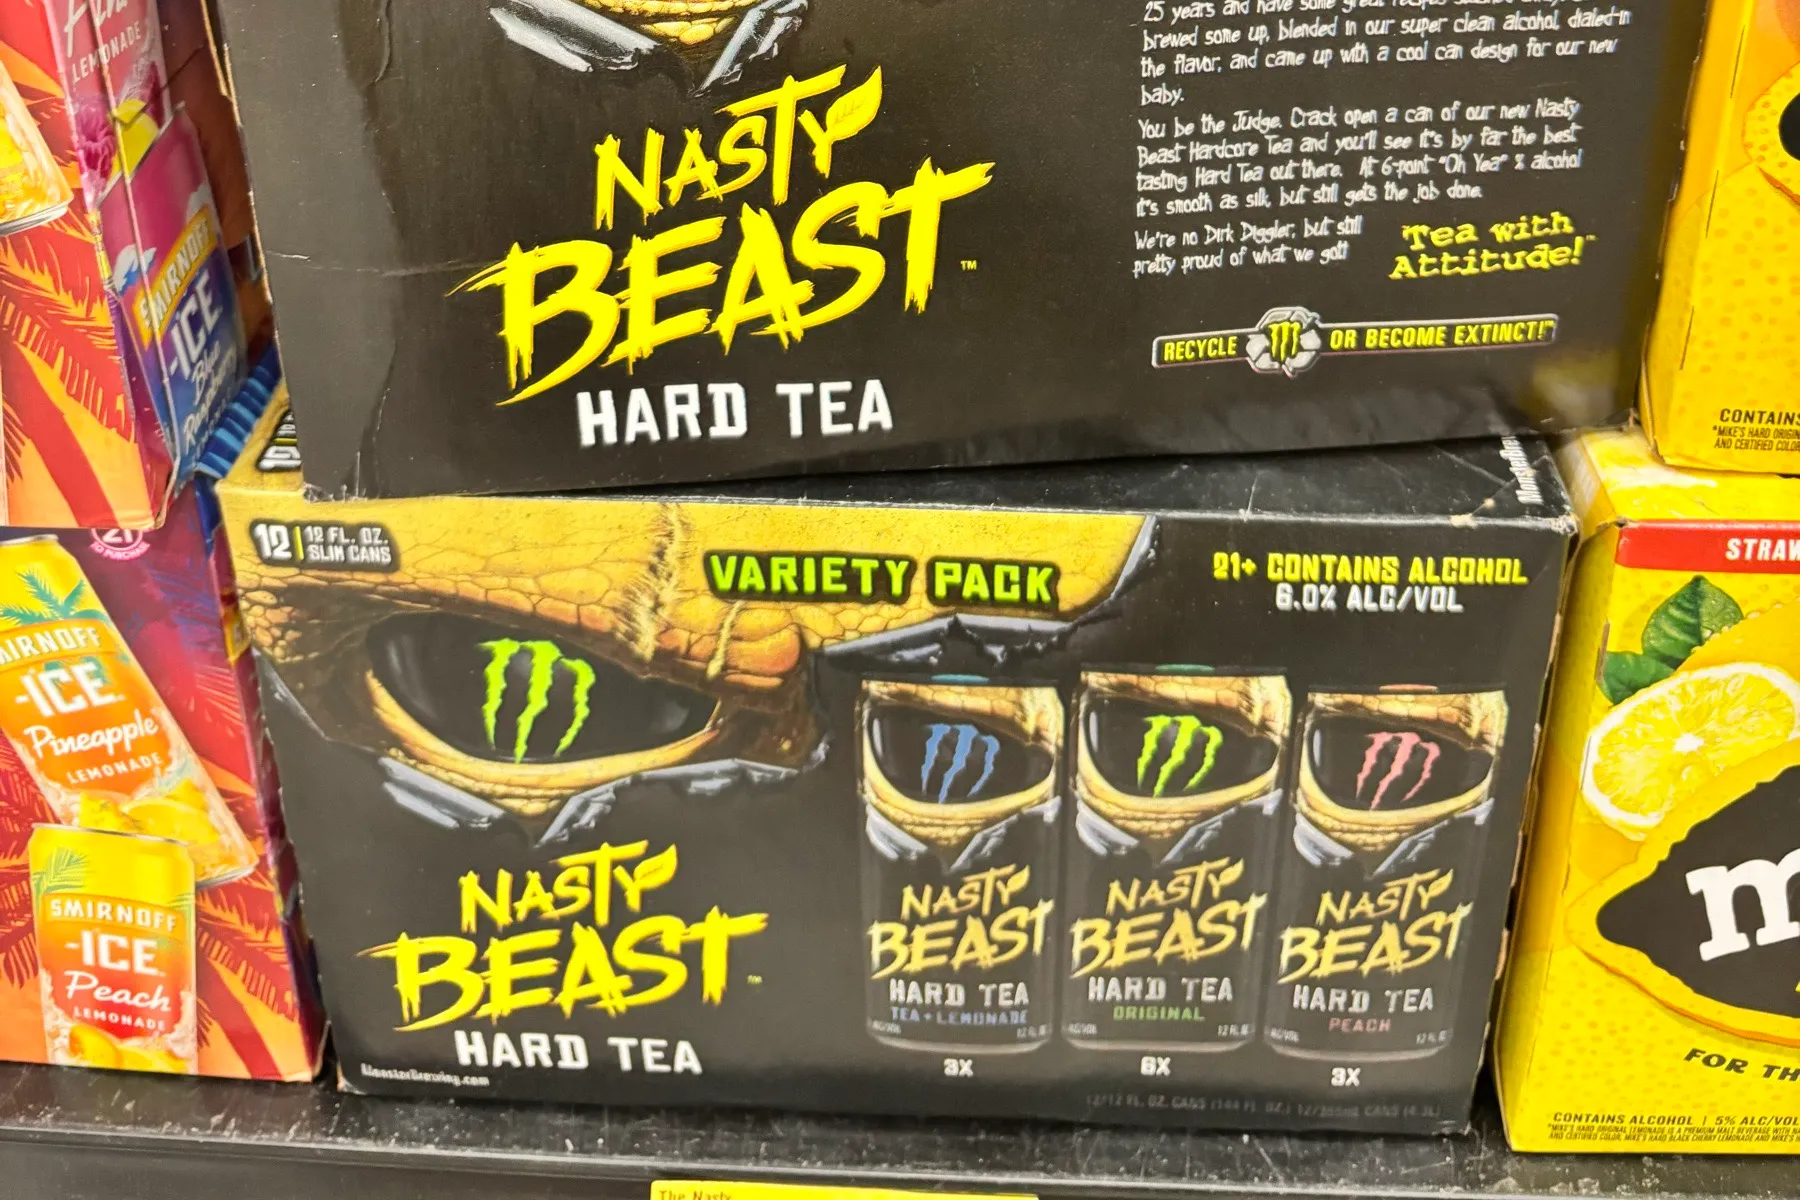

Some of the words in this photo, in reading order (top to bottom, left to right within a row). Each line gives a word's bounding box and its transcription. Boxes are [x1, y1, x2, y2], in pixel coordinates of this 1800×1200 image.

[71, 21, 143, 85] LEMONADE
[1138, 119, 1166, 139] You
[1174, 117, 1195, 136] be
[1201, 114, 1225, 134] the
[1290, 106, 1337, 128] Crack
[1344, 108, 1378, 128] open
[1385, 106, 1398, 123] a
[1405, 106, 1433, 123] can
[1441, 100, 1461, 121] of
[1465, 106, 1496, 121] our
[1500, 104, 1531, 119] new
[1535, 97, 1580, 121] Nasty
[594, 64, 882, 230] NASTY
[1134, 231, 1176, 249] We're
[1182, 232, 1198, 246] no
[1204, 222, 1235, 245] Dirk
[1304, 216, 1334, 238] but
[1336, 215, 1363, 235] still
[1402, 223, 1479, 251] Tea
[1489, 211, 1575, 243] with
[1389, 236, 1585, 280] Attitude!
[445, 157, 996, 406] BEAST
[1163, 336, 1238, 362] RECYCLE
[1330, 329, 1357, 349] OR
[1365, 327, 1448, 348] BECOME
[576, 382, 748, 447] HARD
[776, 380, 894, 436] TEA
[1714, 437, 1732, 449] AND
[254, 523, 292, 560] 12
[304, 526, 324, 543] 12
[327, 526, 356, 544] FL.
[359, 527, 388, 545] OZ.
[307, 544, 345, 561] SLIM
[347, 545, 392, 565] CANS
[1213, 553, 1257, 581] 21+
[1267, 553, 1399, 584] CONTAINS
[1408, 557, 1529, 585] ALCOHOL
[709, 555, 911, 597] VARIETY
[934, 561, 1057, 600] PACK
[1275, 583, 1337, 611] 6.0%
[1346, 585, 1464, 612] ALC/VOL
[23, 708, 159, 759] Pineapple
[66, 752, 162, 784] LEMONADE
[458, 839, 678, 933] NASTY
[901, 864, 1030, 920] NASTY
[1106, 857, 1245, 915] NASTY
[1315, 868, 1454, 926] NASTY
[50, 898, 178, 933] SMIRNOFF
[866, 899, 1055, 980] BEAST
[1070, 893, 1268, 980] BEAST
[1277, 902, 1474, 985] BEAST
[356, 906, 769, 1032] BEAST
[64, 970, 171, 1013] Peach
[889, 978, 965, 1006] HARD
[979, 982, 1030, 1007] TEA
[1088, 976, 1166, 1002] HARD
[1182, 976, 1234, 1003] TEA
[1293, 984, 1370, 1014] HARD
[1385, 987, 1434, 1013] TEA
[73, 1006, 167, 1032] LEMONADE
[1113, 1005, 1205, 1022] ORIGINAL
[1328, 1017, 1391, 1033] PEACH
[453, 1030, 589, 1070] HARD
[607, 1036, 702, 1074] TEA
[943, 1058, 973, 1077] 3X
[1140, 1056, 1171, 1076] 6X
[1683, 1047, 1749, 1074] FOR
[1330, 1067, 1361, 1087] 3X
[1553, 1111, 1626, 1124] CONTAINS
[1629, 1115, 1693, 1126] ALCOHOL
[1714, 1115, 1737, 1126] 5%
[1740, 1115, 1800, 1127] ALC/VOL
